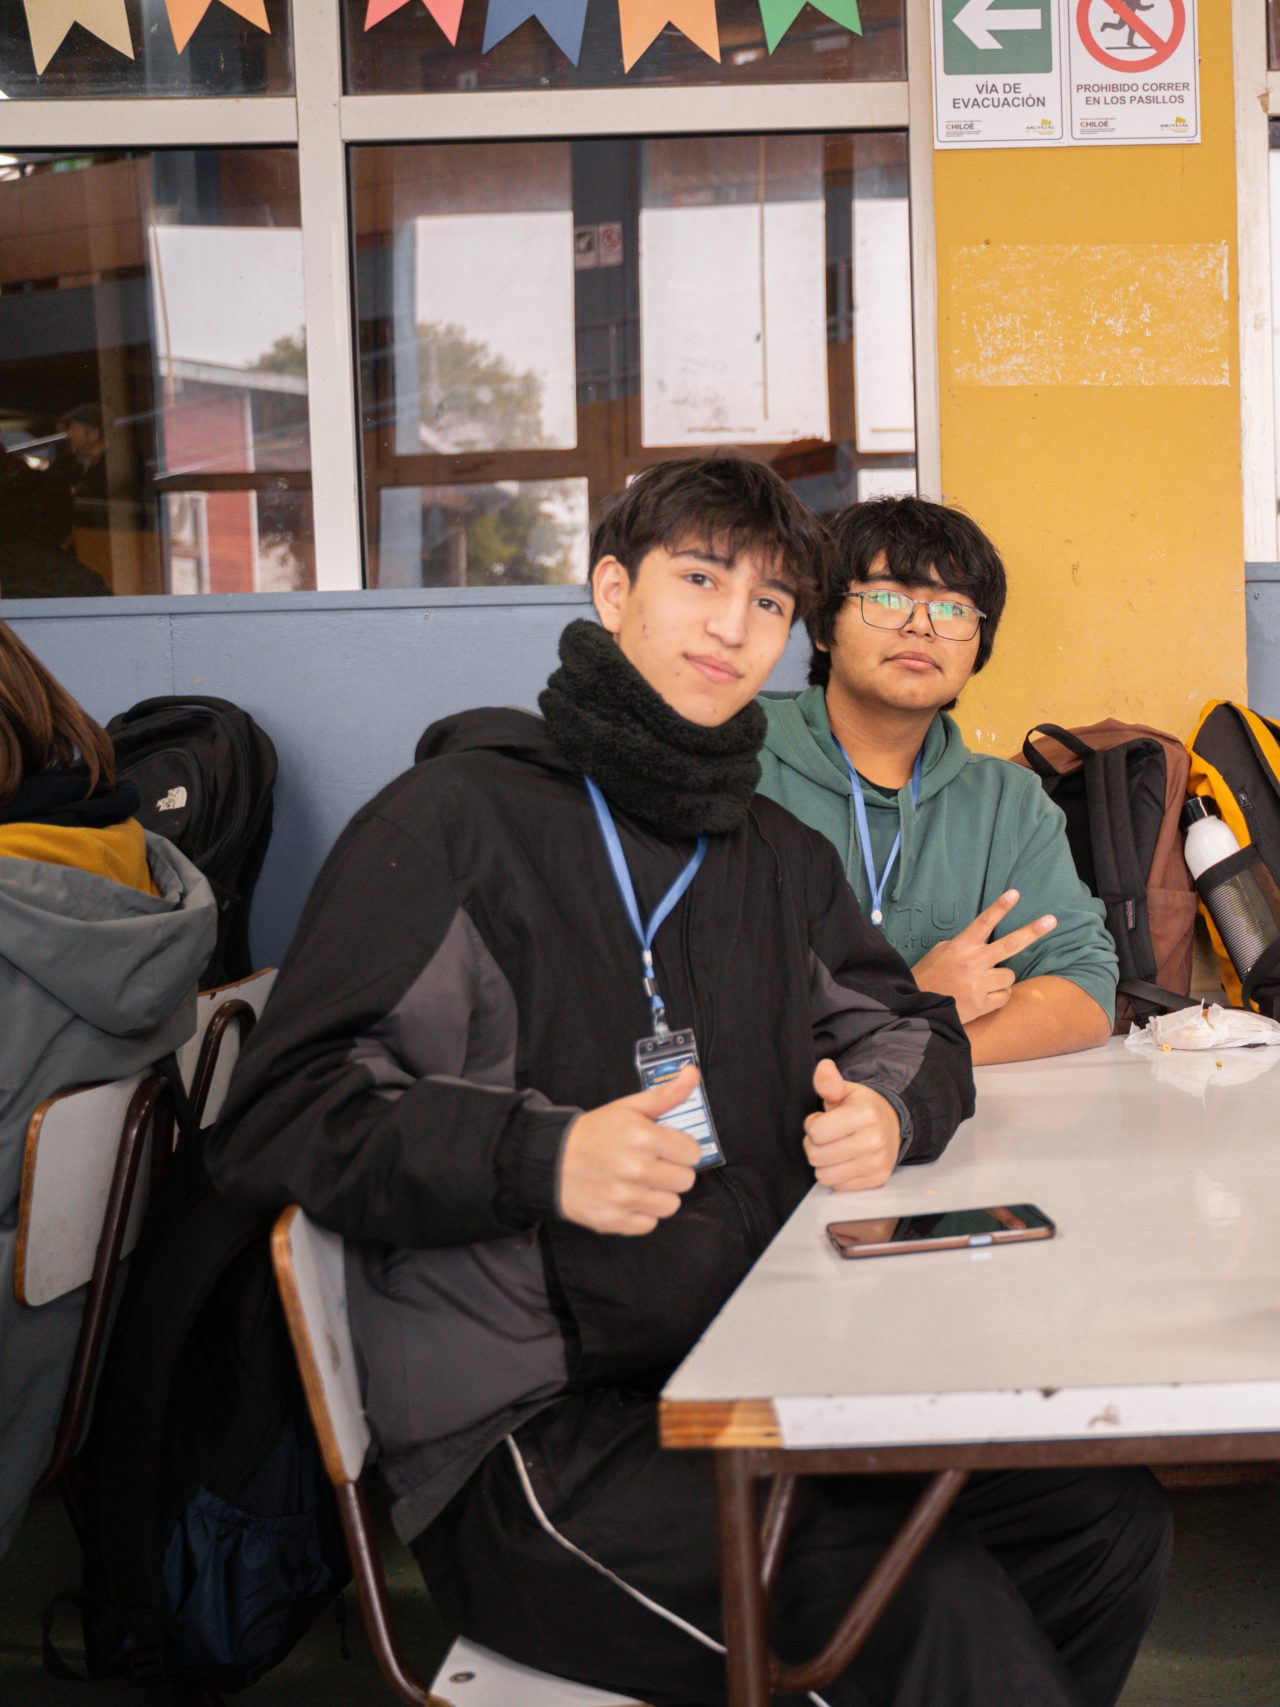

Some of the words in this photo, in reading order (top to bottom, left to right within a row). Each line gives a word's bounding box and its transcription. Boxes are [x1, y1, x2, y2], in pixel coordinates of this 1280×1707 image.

[976, 81, 999, 94] VÍA
[1003, 83, 1022, 94] DE
[1076, 83, 1139, 93] PROHIBIDO
[1142, 82, 1190, 92] CORRER
[952, 94, 1046, 109] EVACUACIÓN
[1085, 96, 1100, 105] EN
[1104, 96, 1126, 105] LOS
[1130, 95, 1185, 104] PASILLOS
[945, 122, 974, 130] CHILOÉ
[1080, 120, 1108, 128] CHILOÉ
